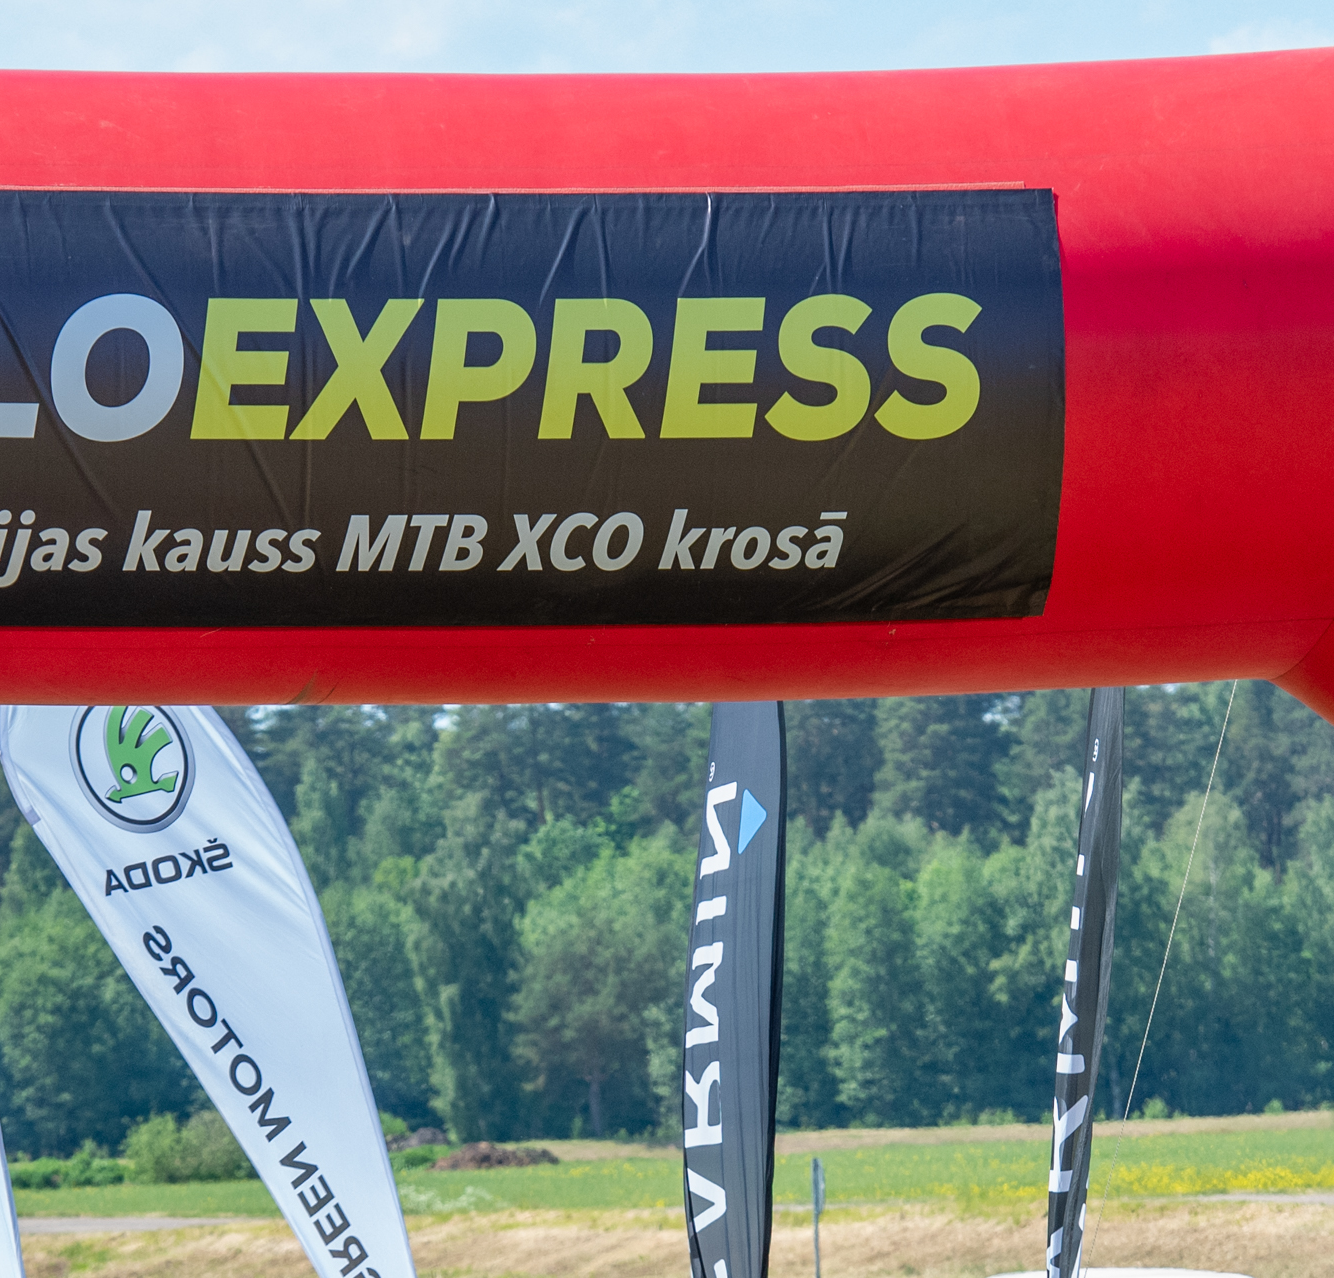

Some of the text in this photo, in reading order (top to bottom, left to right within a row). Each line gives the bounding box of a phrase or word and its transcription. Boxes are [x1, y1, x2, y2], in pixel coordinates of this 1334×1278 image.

[123, 511, 321, 574] kauss
[337, 513, 485, 573] MTB
[497, 511, 645, 575] XCO
[659, 508, 847, 573] krosā
